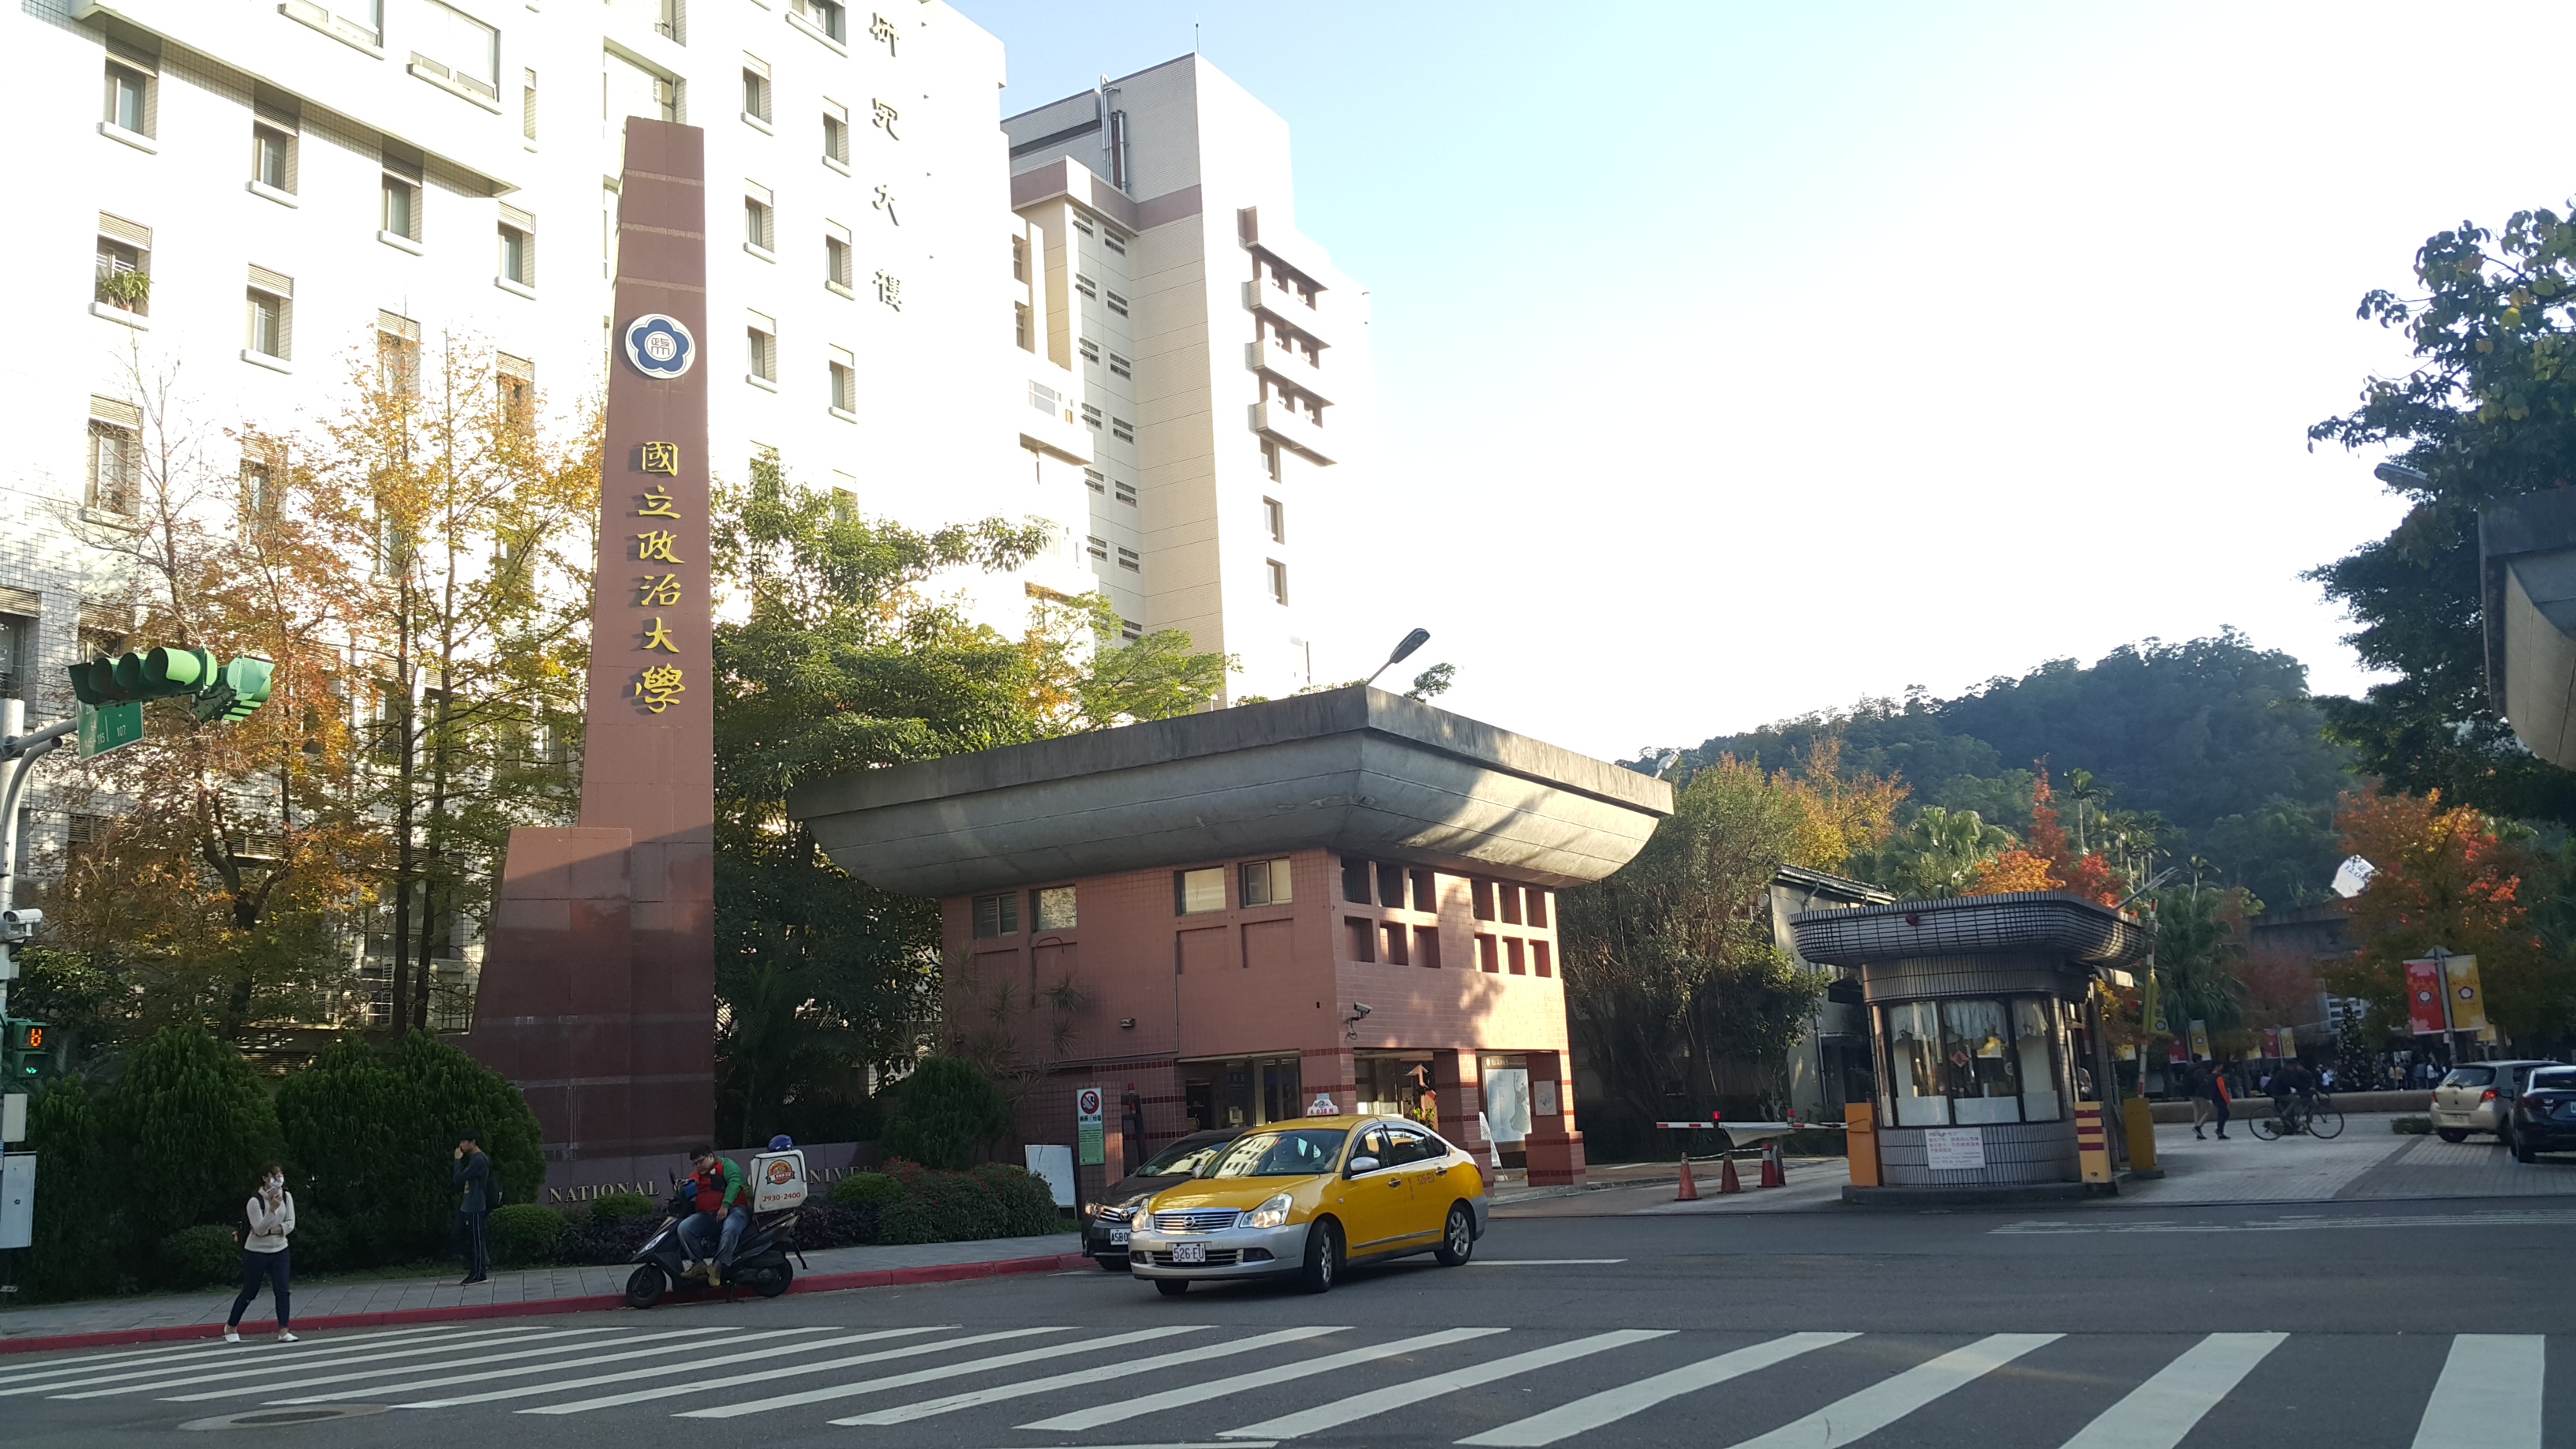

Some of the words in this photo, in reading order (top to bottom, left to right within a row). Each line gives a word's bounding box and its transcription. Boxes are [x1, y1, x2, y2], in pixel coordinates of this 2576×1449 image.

[635, 441, 686, 713] 國立政治大學
[117, 724, 126, 737] 107
[549, 1181, 660, 1203] NATIONAL
[763, 1192, 801, 1202] 2930-2400
[1174, 1248, 1204, 1260] 526-EU
